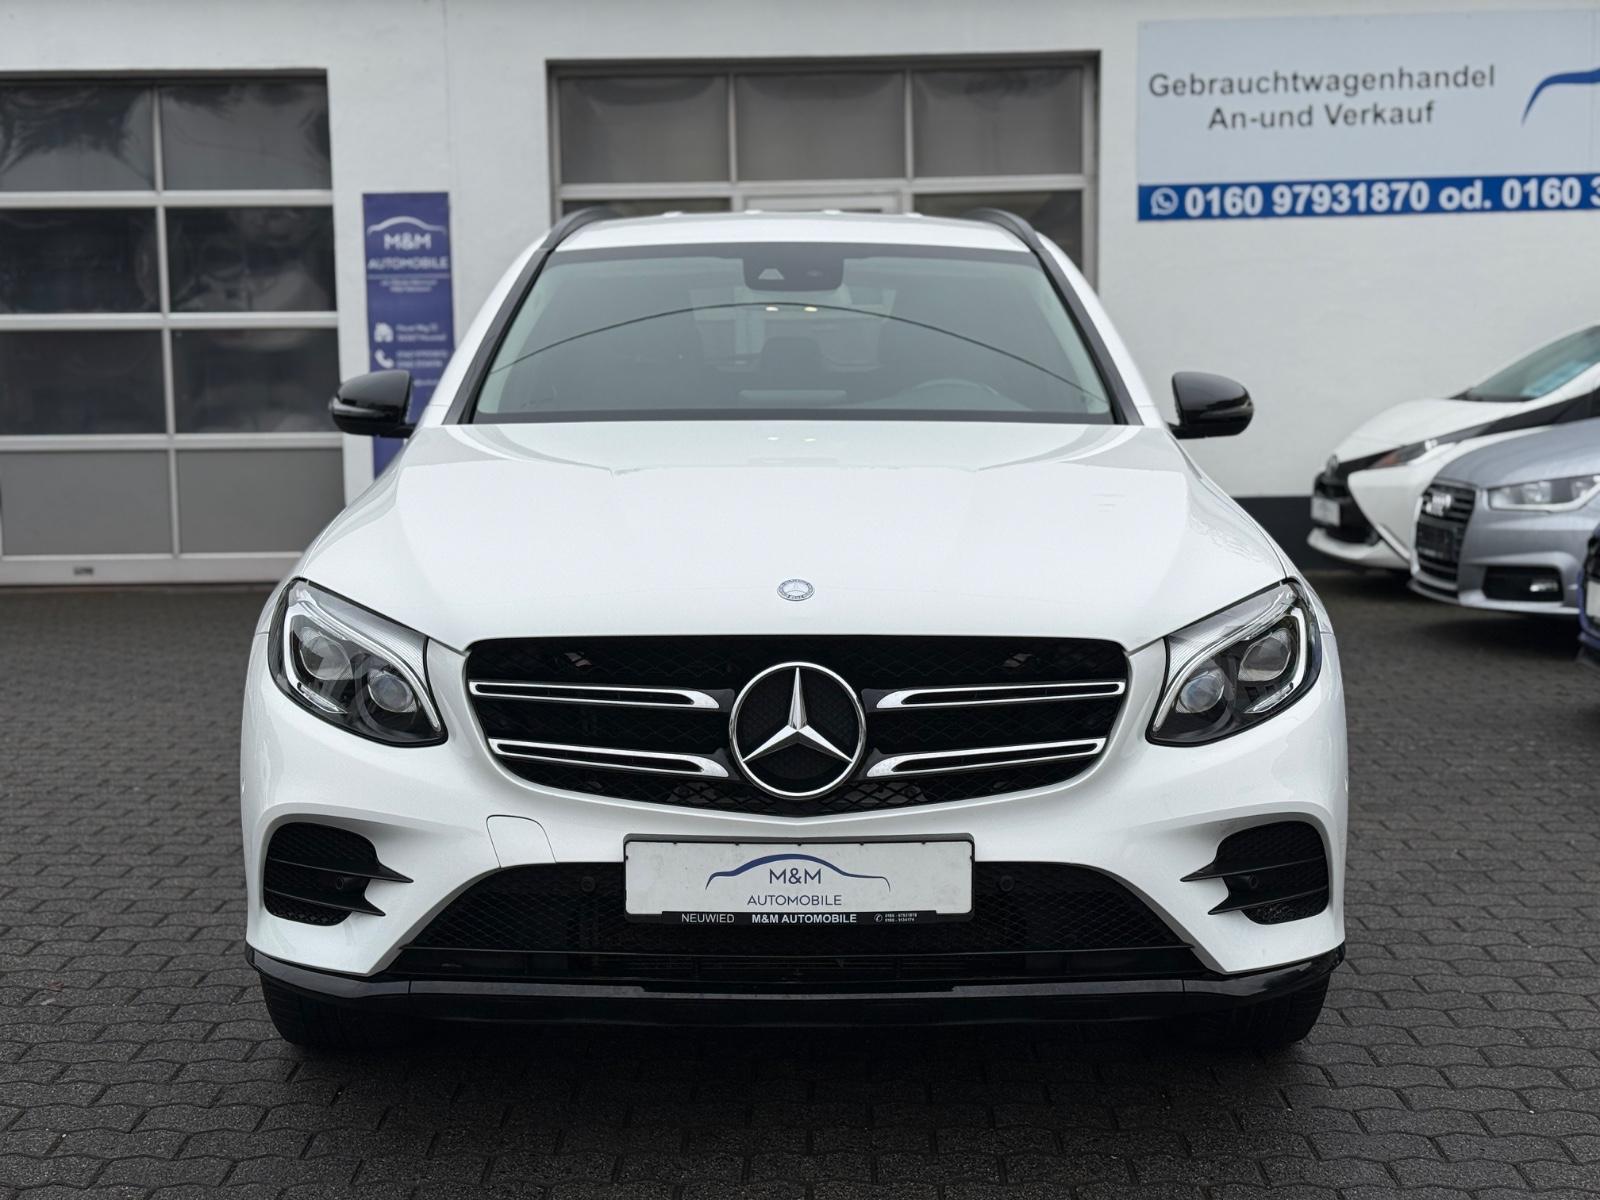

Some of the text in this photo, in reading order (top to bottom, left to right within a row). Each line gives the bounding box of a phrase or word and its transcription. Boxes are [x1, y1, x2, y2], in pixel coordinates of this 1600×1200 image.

[1149, 65, 1495, 98] Gebrauchtwagenhandel
[1208, 101, 1435, 130] An-und Verkauf
[1184, 185, 1262, 217] 0160
[1272, 181, 1430, 215] 97931870
[1439, 180, 1492, 211] od.
[1501, 176, 1582, 209] 0160
[384, 232, 431, 251] M&M
[367, 256, 449, 271] AUTOMOBILE
[769, 868, 822, 885] M&M
[747, 894, 842, 907] AUTOMOBILE
[681, 913, 857, 924] NEUWIED M&M AUTOMOBILE
